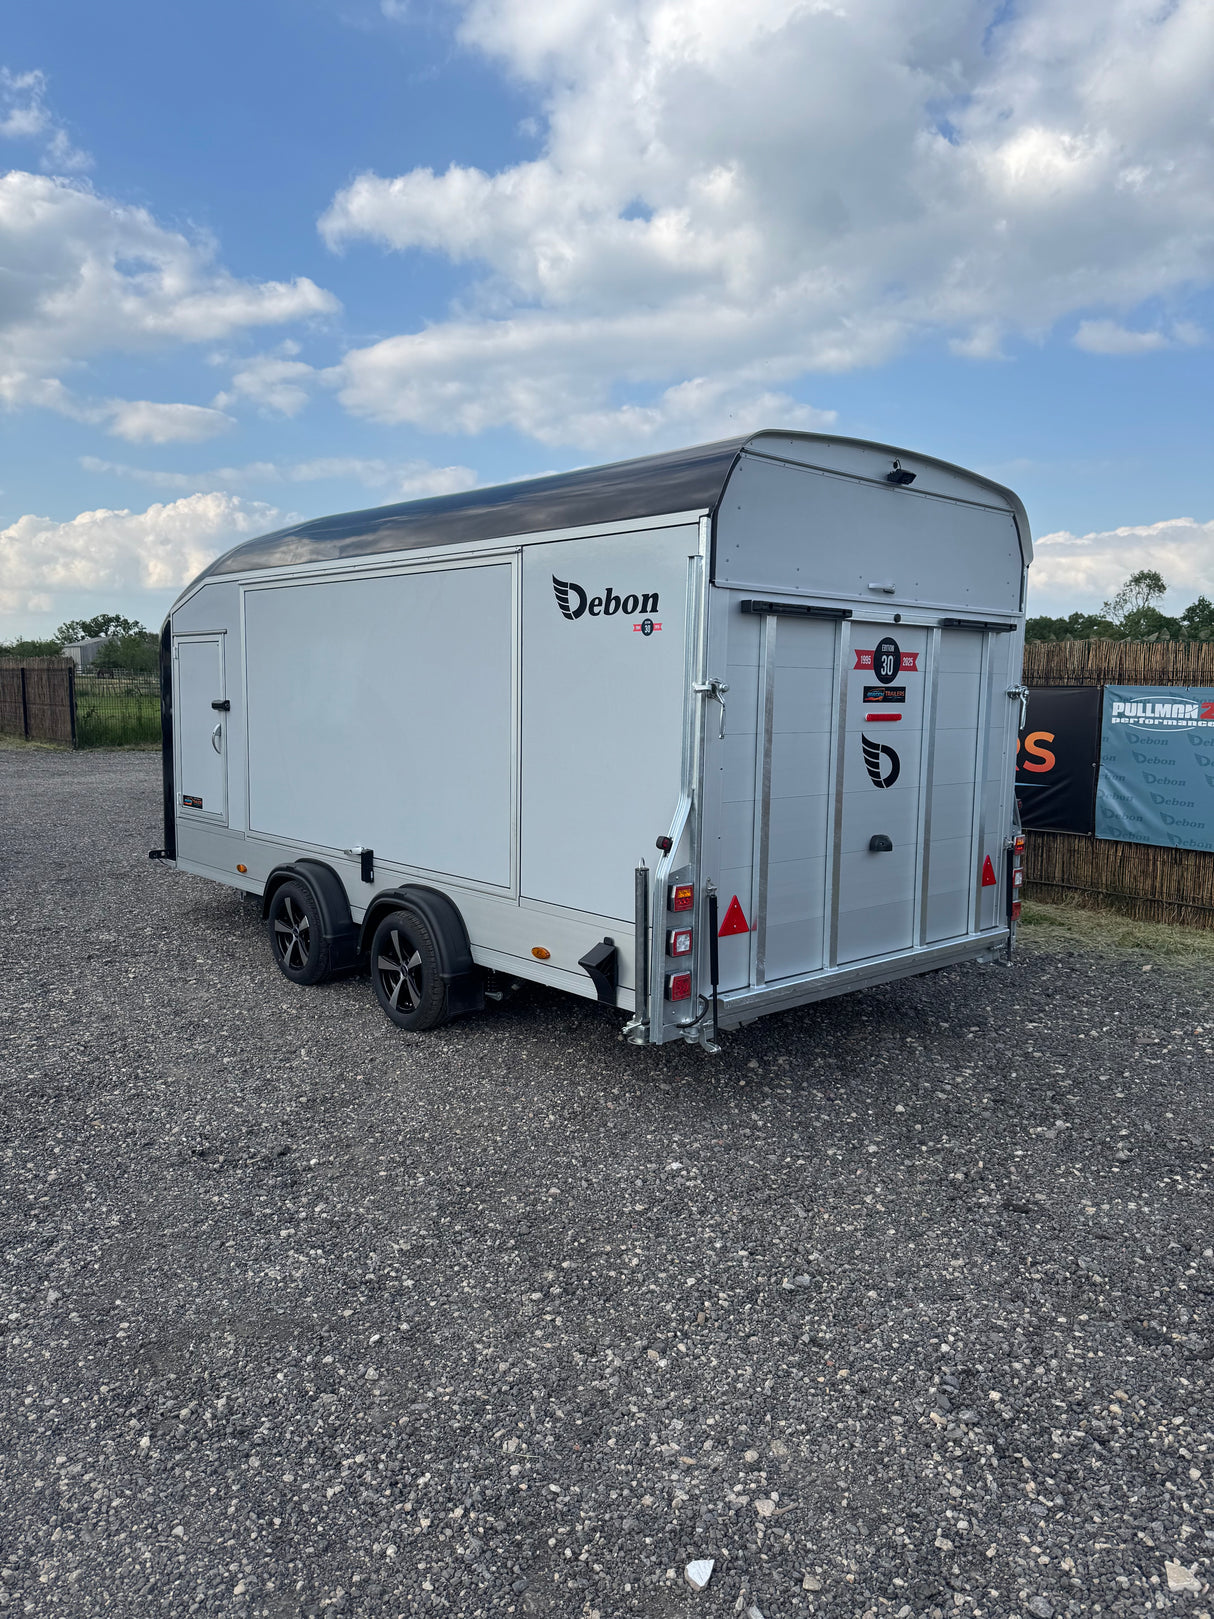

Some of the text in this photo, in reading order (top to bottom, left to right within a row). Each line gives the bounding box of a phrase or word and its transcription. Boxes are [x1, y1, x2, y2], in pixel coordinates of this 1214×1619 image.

[552, 574, 660, 620] Debon
[880, 655, 894, 676] 30
[1112, 702, 1199, 719] PULLMAN
[1111, 717, 1214, 727] performance
[1125, 731, 1169, 746] Debon
[1016, 731, 1056, 773] S
[1132, 750, 1176, 765] Debon
[1142, 770, 1186, 786] Debon
[1150, 791, 1195, 808] Debon
[1159, 812, 1206, 829] Debon
[1167, 831, 1213, 849] Debon
